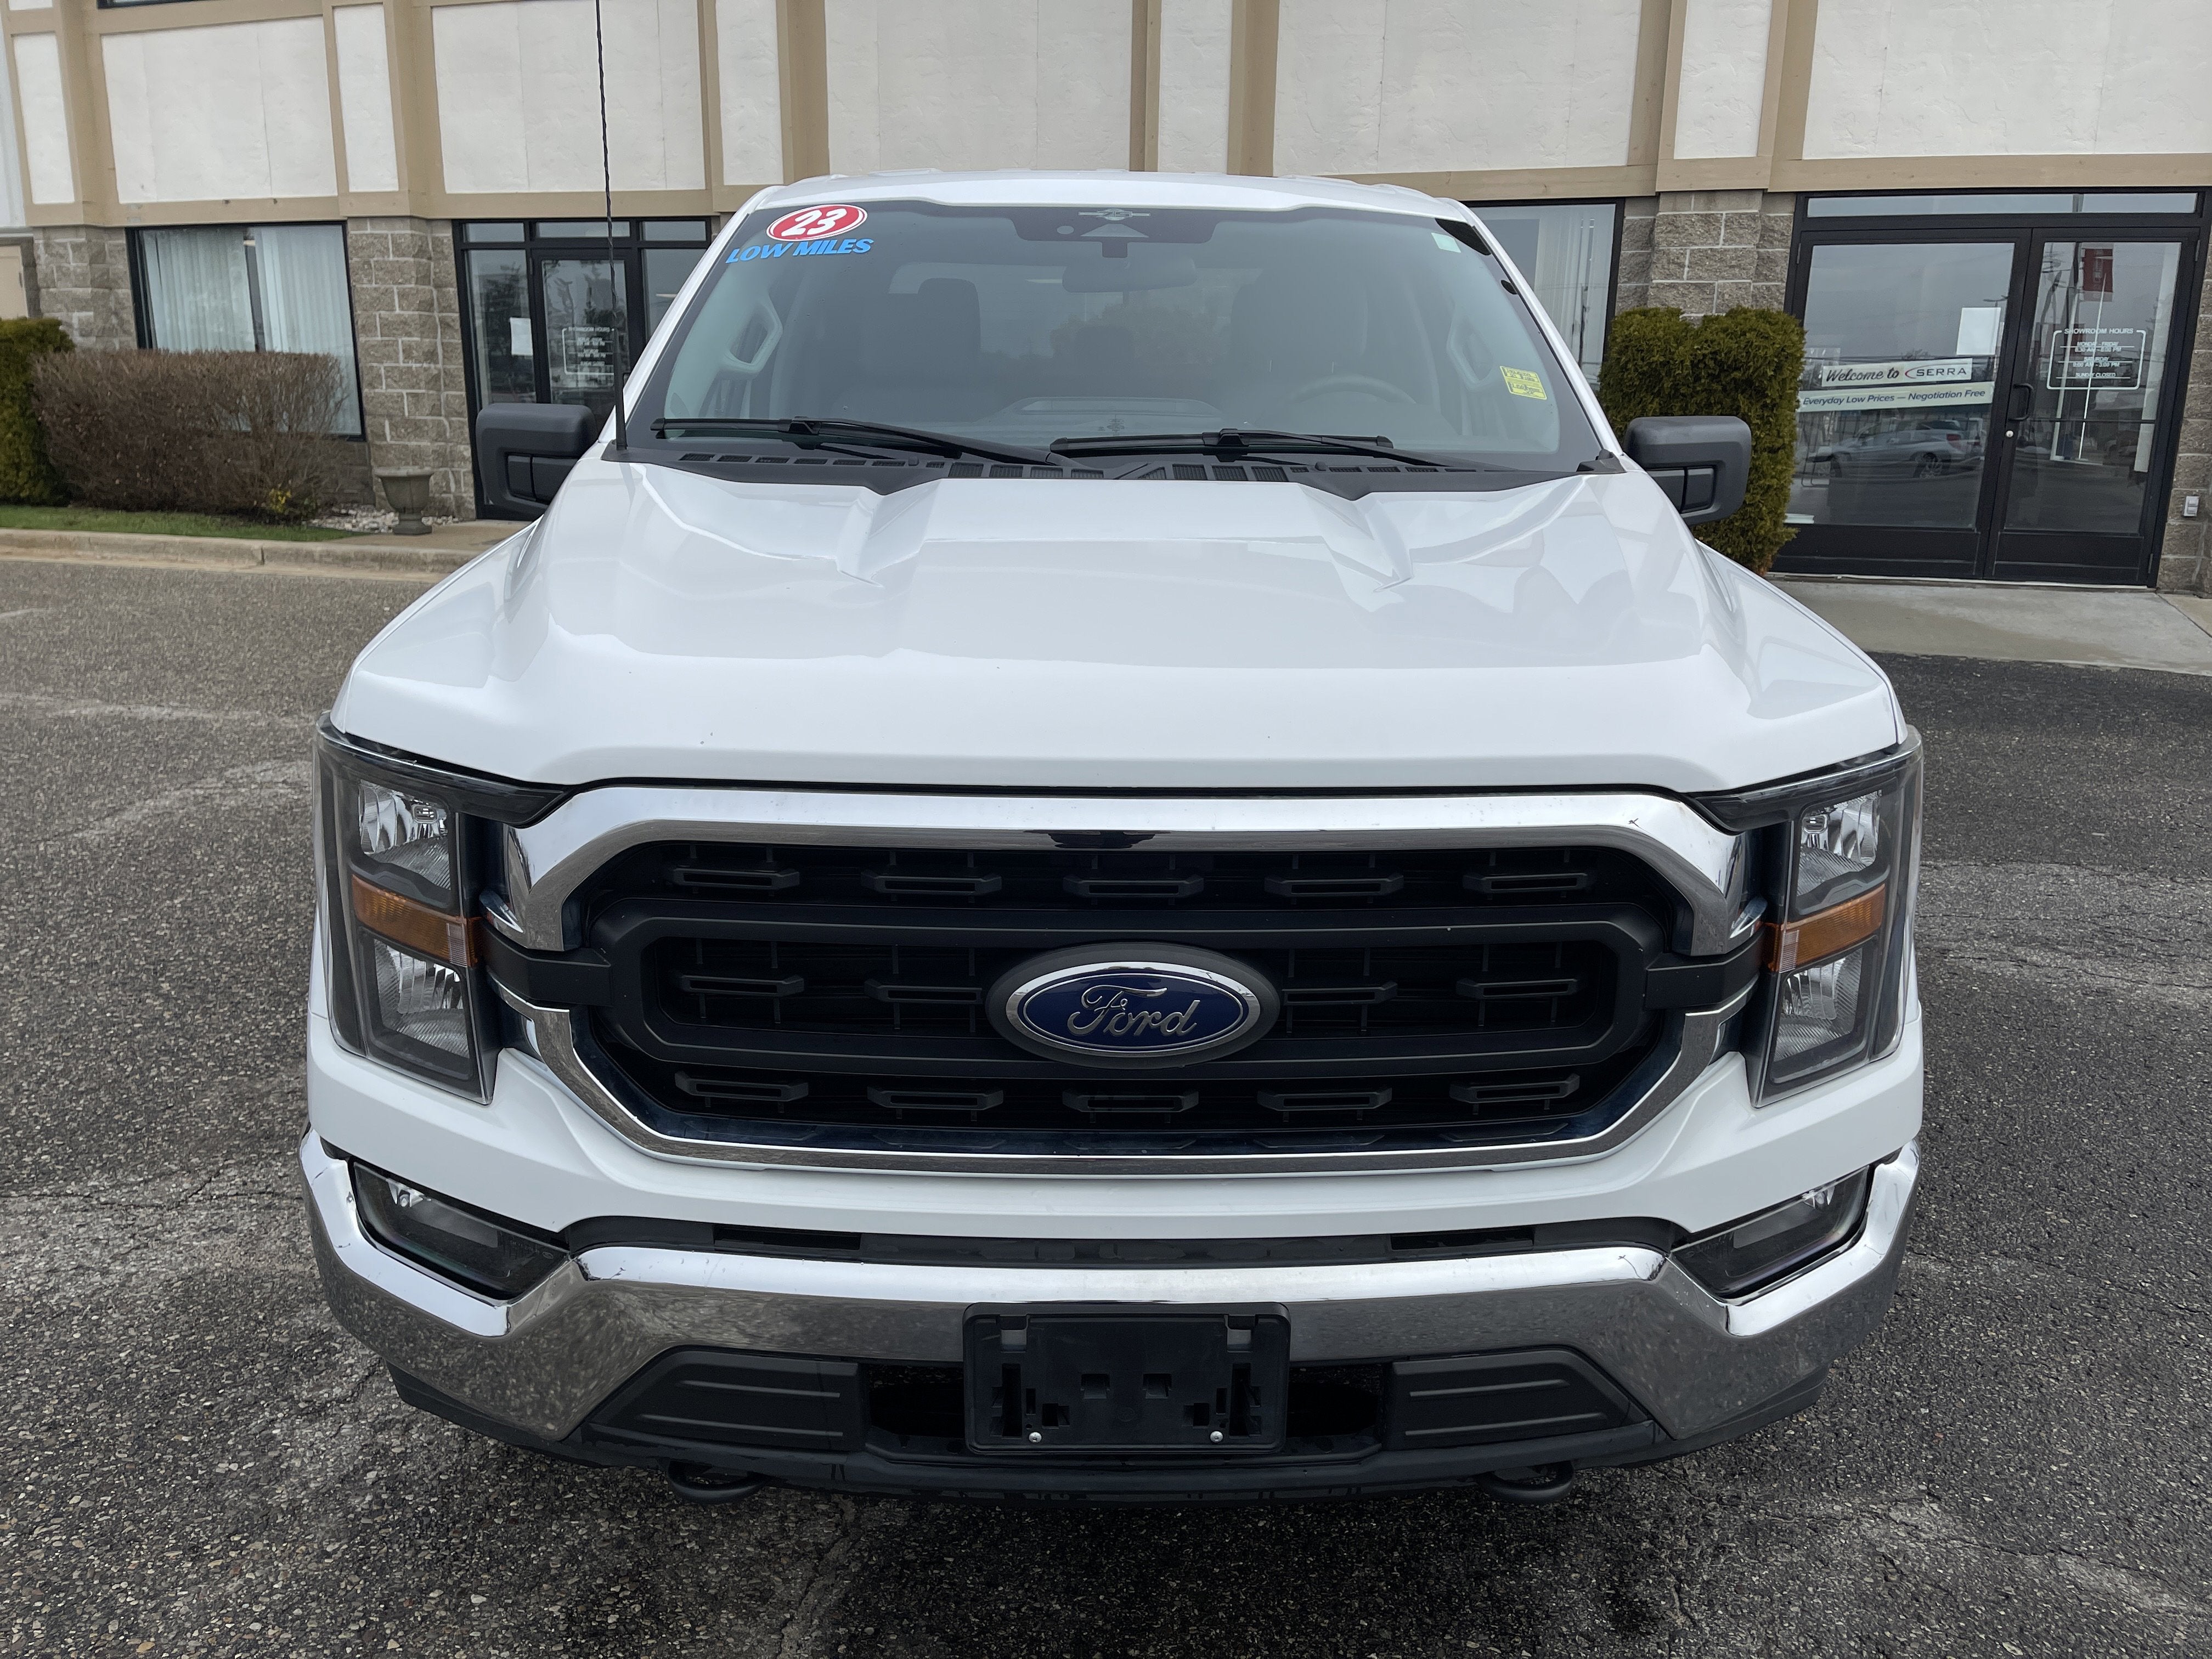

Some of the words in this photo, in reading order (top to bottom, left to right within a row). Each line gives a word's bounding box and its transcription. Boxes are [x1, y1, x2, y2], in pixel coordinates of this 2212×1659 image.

[781, 207, 848, 237] 23
[725, 241, 794, 263] LOW
[792, 238, 874, 256] MILES
[1826, 368, 1884, 382] Welcome
[1887, 367, 1900, 379] to
[1916, 367, 1967, 377] SERRA
[1803, 397, 1845, 406] Everyday
[1908, 391, 1962, 401] Negotiation
[1066, 984, 1201, 1037] Ford
